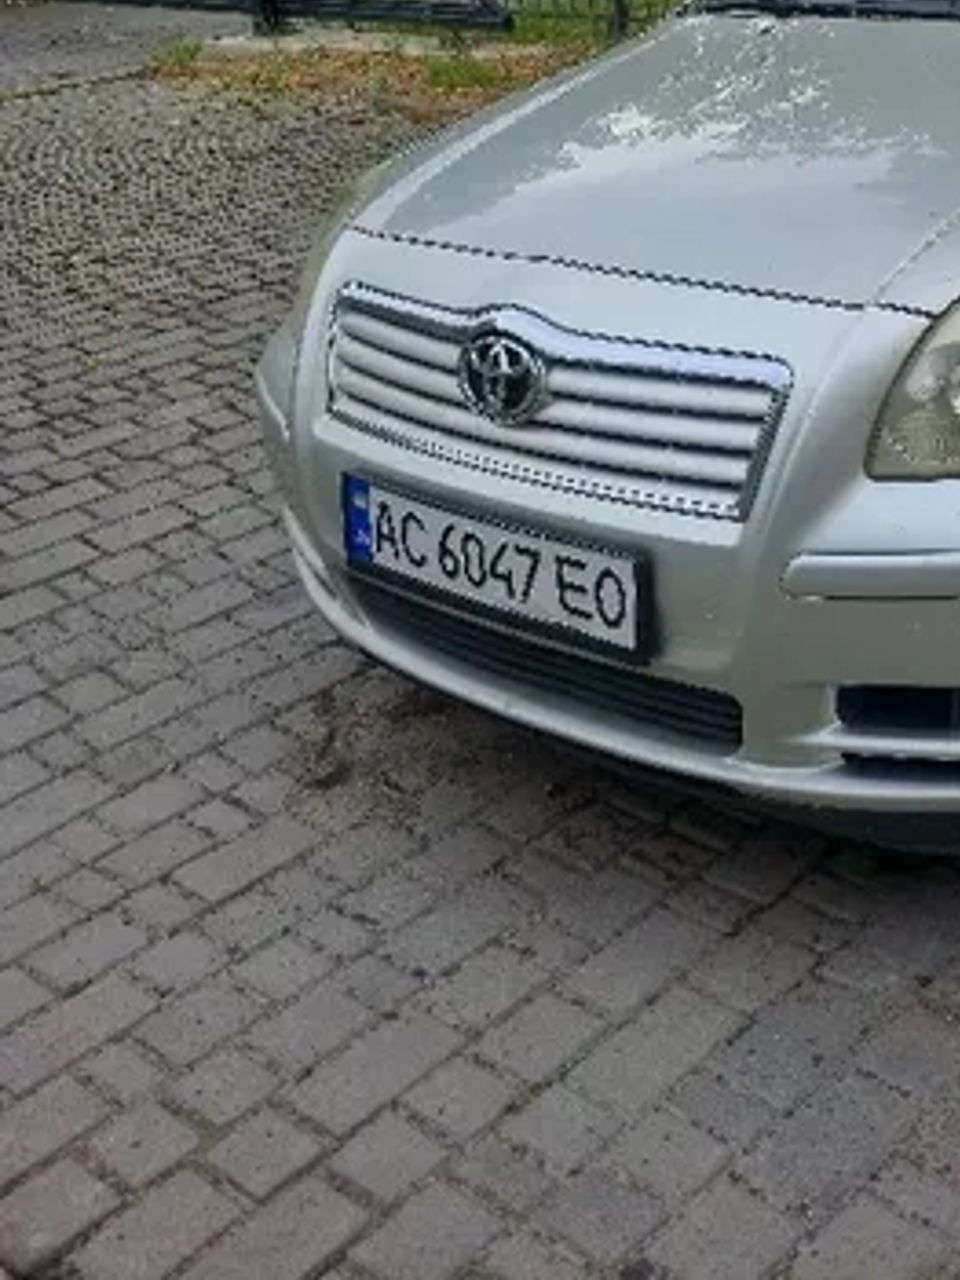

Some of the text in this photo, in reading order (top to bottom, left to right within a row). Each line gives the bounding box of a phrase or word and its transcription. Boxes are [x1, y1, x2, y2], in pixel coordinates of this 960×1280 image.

[376, 503, 626, 628] AC 6047 EO
